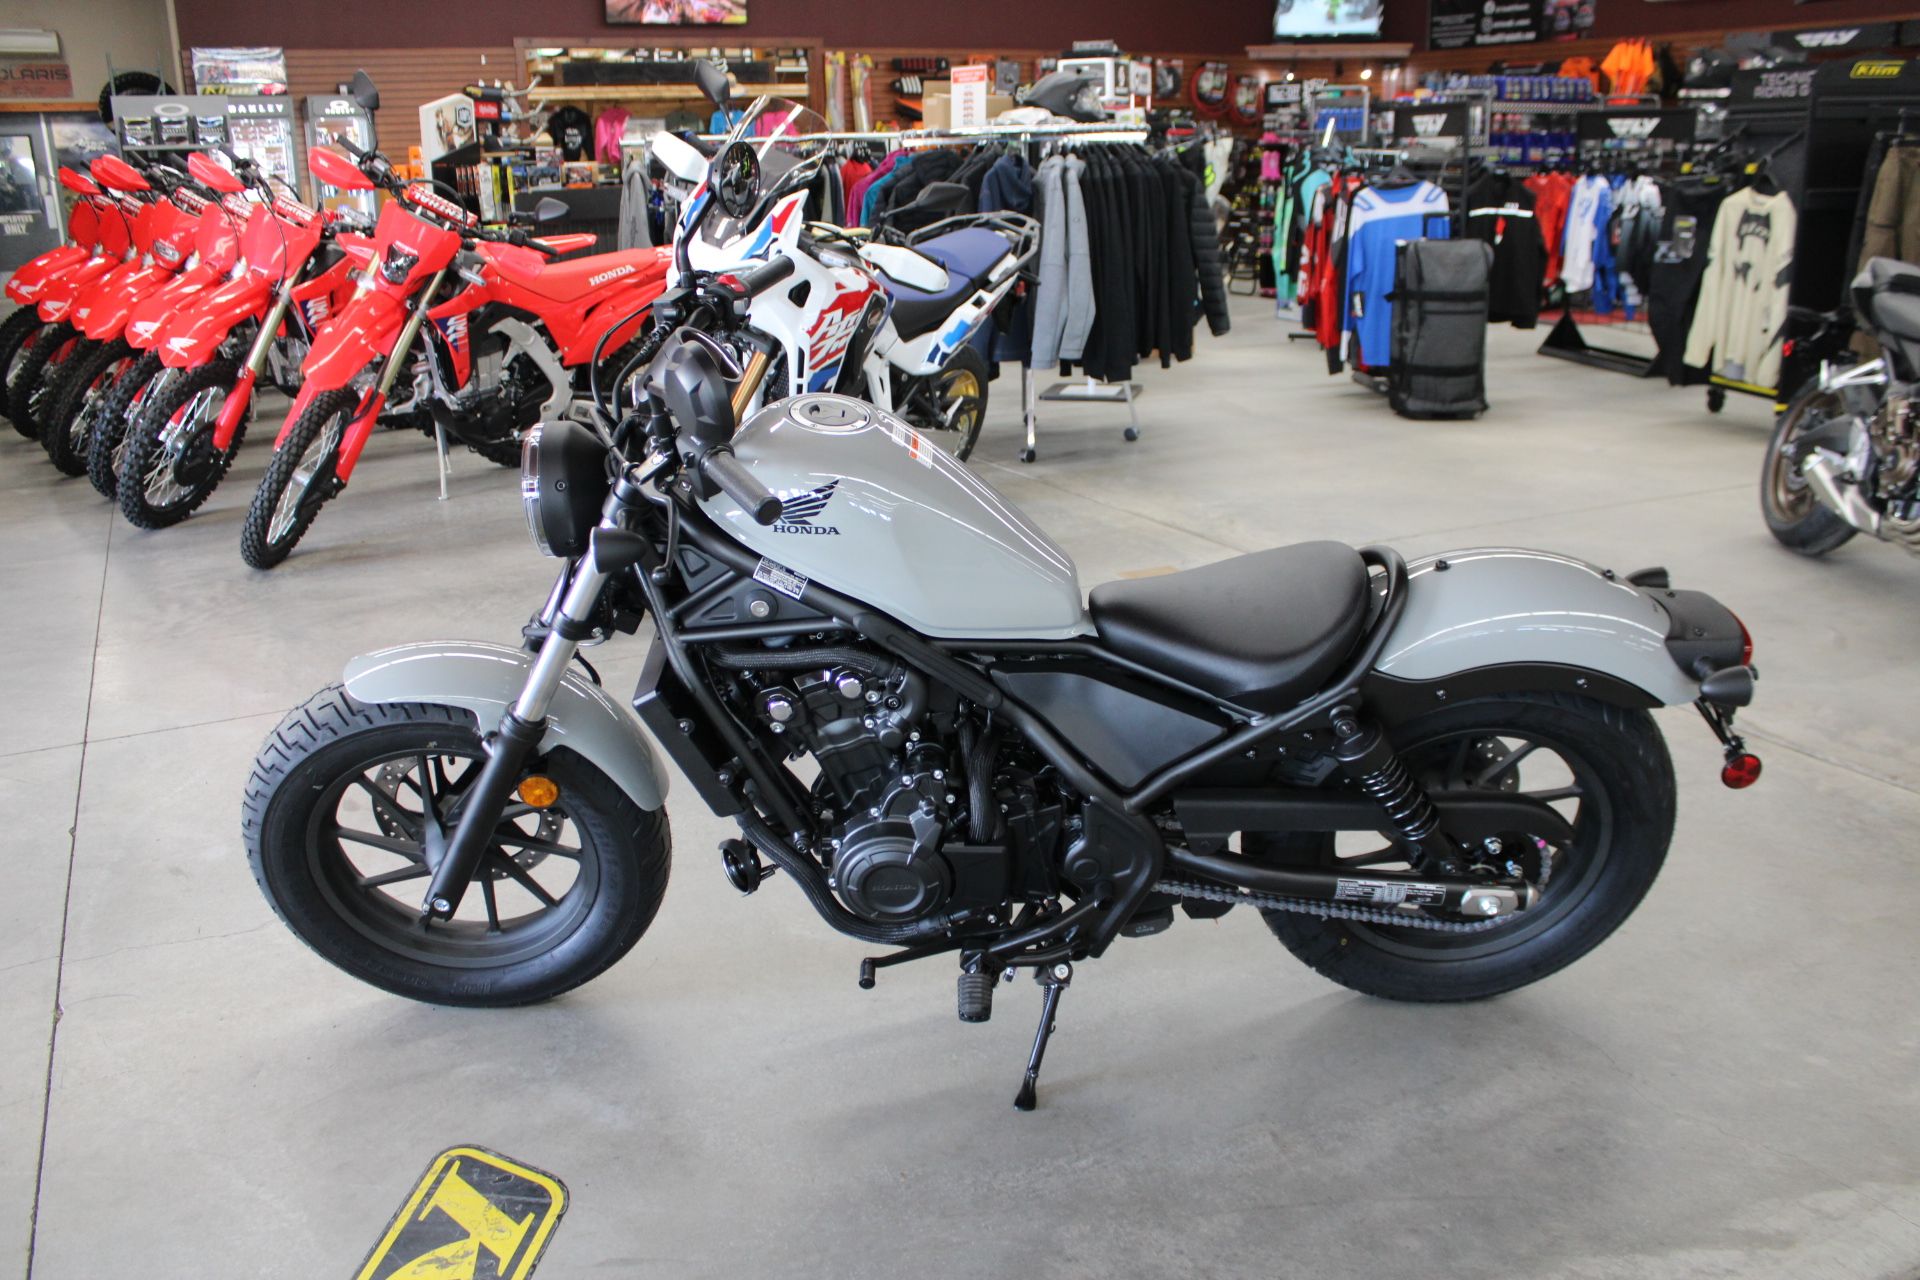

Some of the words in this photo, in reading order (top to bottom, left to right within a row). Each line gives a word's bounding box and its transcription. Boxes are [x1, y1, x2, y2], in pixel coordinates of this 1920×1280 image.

[227, 103, 284, 114] OAKLEY
[588, 264, 636, 287] HONDA
[772, 524, 841, 536] HONDA
